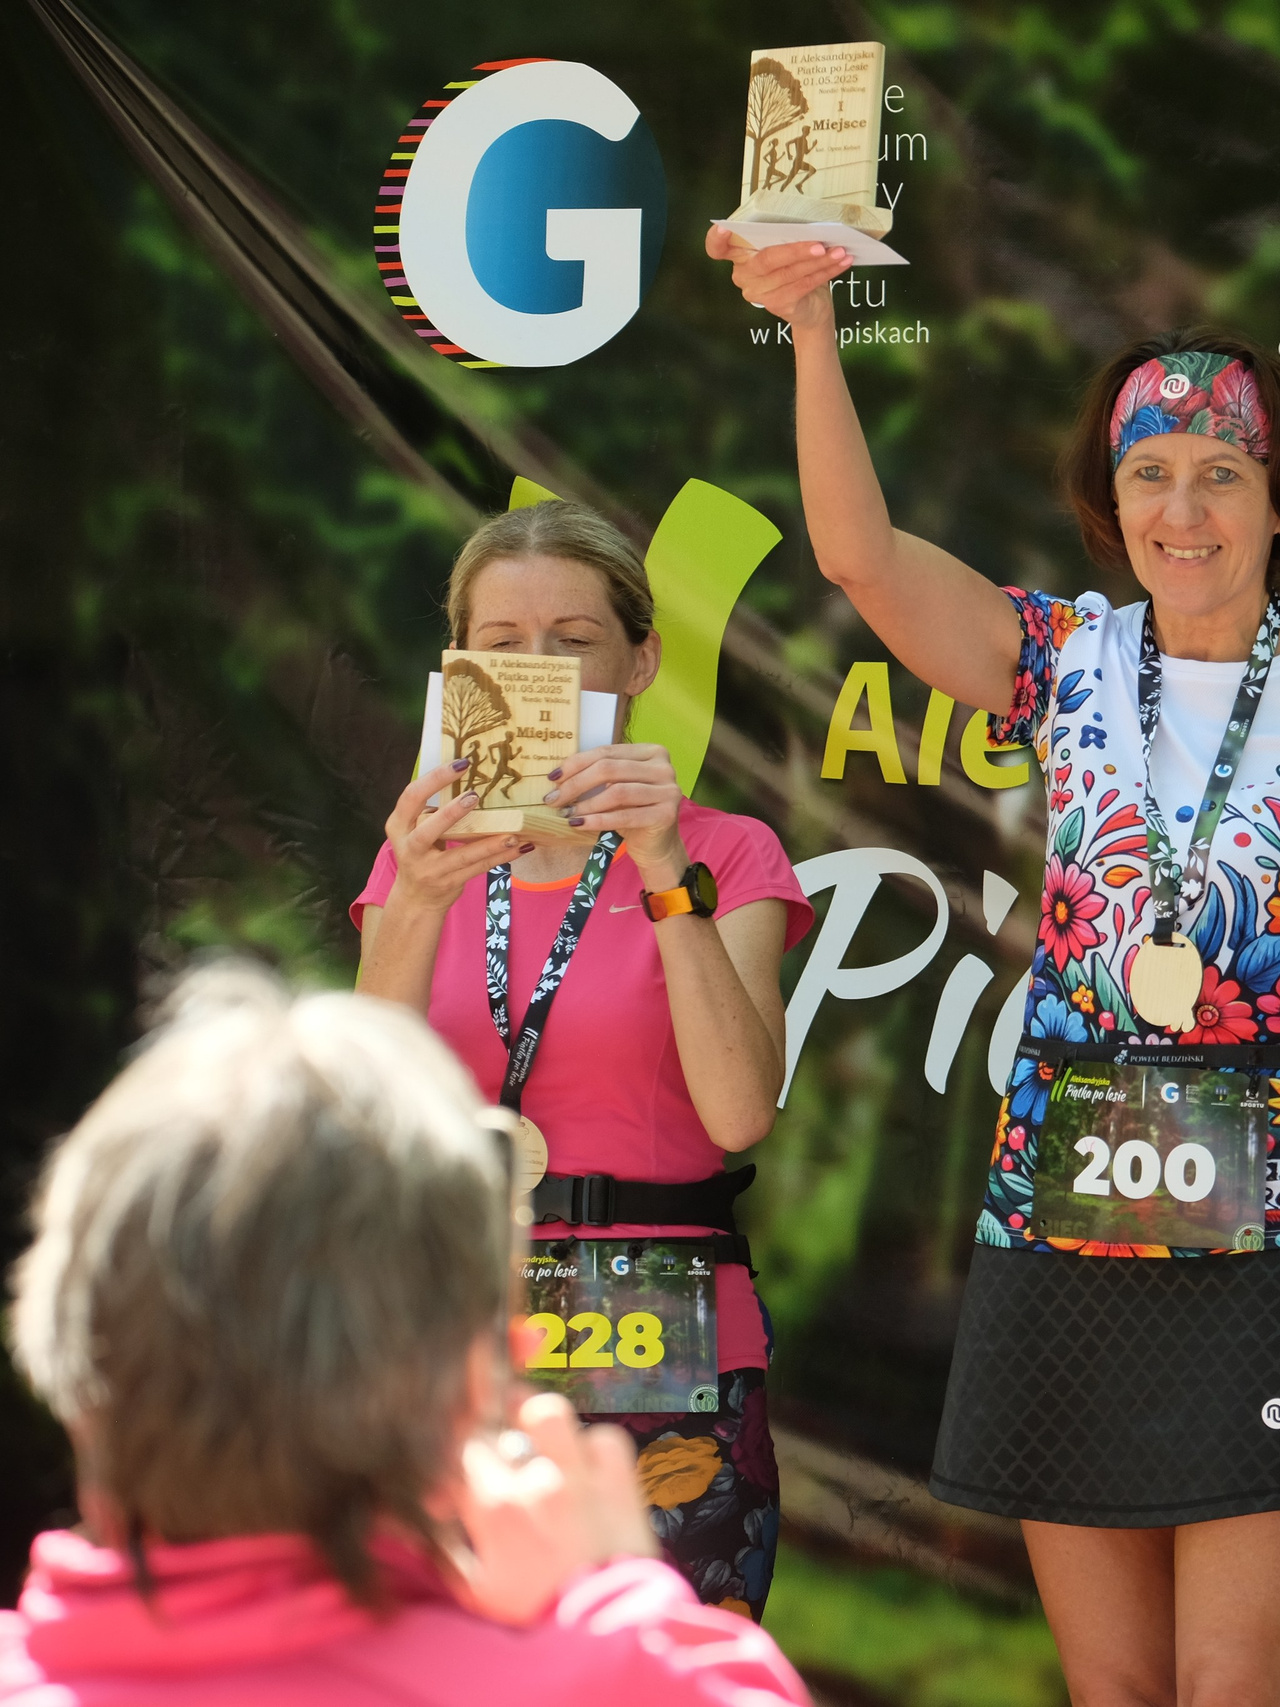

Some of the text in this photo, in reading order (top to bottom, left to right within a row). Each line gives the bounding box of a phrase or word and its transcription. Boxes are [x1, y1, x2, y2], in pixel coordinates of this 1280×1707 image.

[800, 50, 875, 65] Aleksandryjska
[830, 65, 841, 75] po
[844, 63, 869, 72] Lesie
[803, 74, 858, 87] 01.05.2025
[812, 118, 867, 133] Miejsce
[750, 320, 930, 349] w Kpiskach
[532, 675, 546, 685] po
[548, 674, 573, 683] Lesie
[504, 685, 563, 694] 01.05.2025
[539, 711, 552, 722] II
[516, 727, 573, 742] Miejsce
[1130, 1055, 1159, 1063] POWIAT
[1091, 1089, 1105, 1104] po
[1105, 1086, 1127, 1102] lesie
[1073, 1136, 1216, 1203] 200
[536, 1267, 551, 1282] po
[554, 1263, 578, 1279] lesie
[522, 1312, 665, 1368] 228
